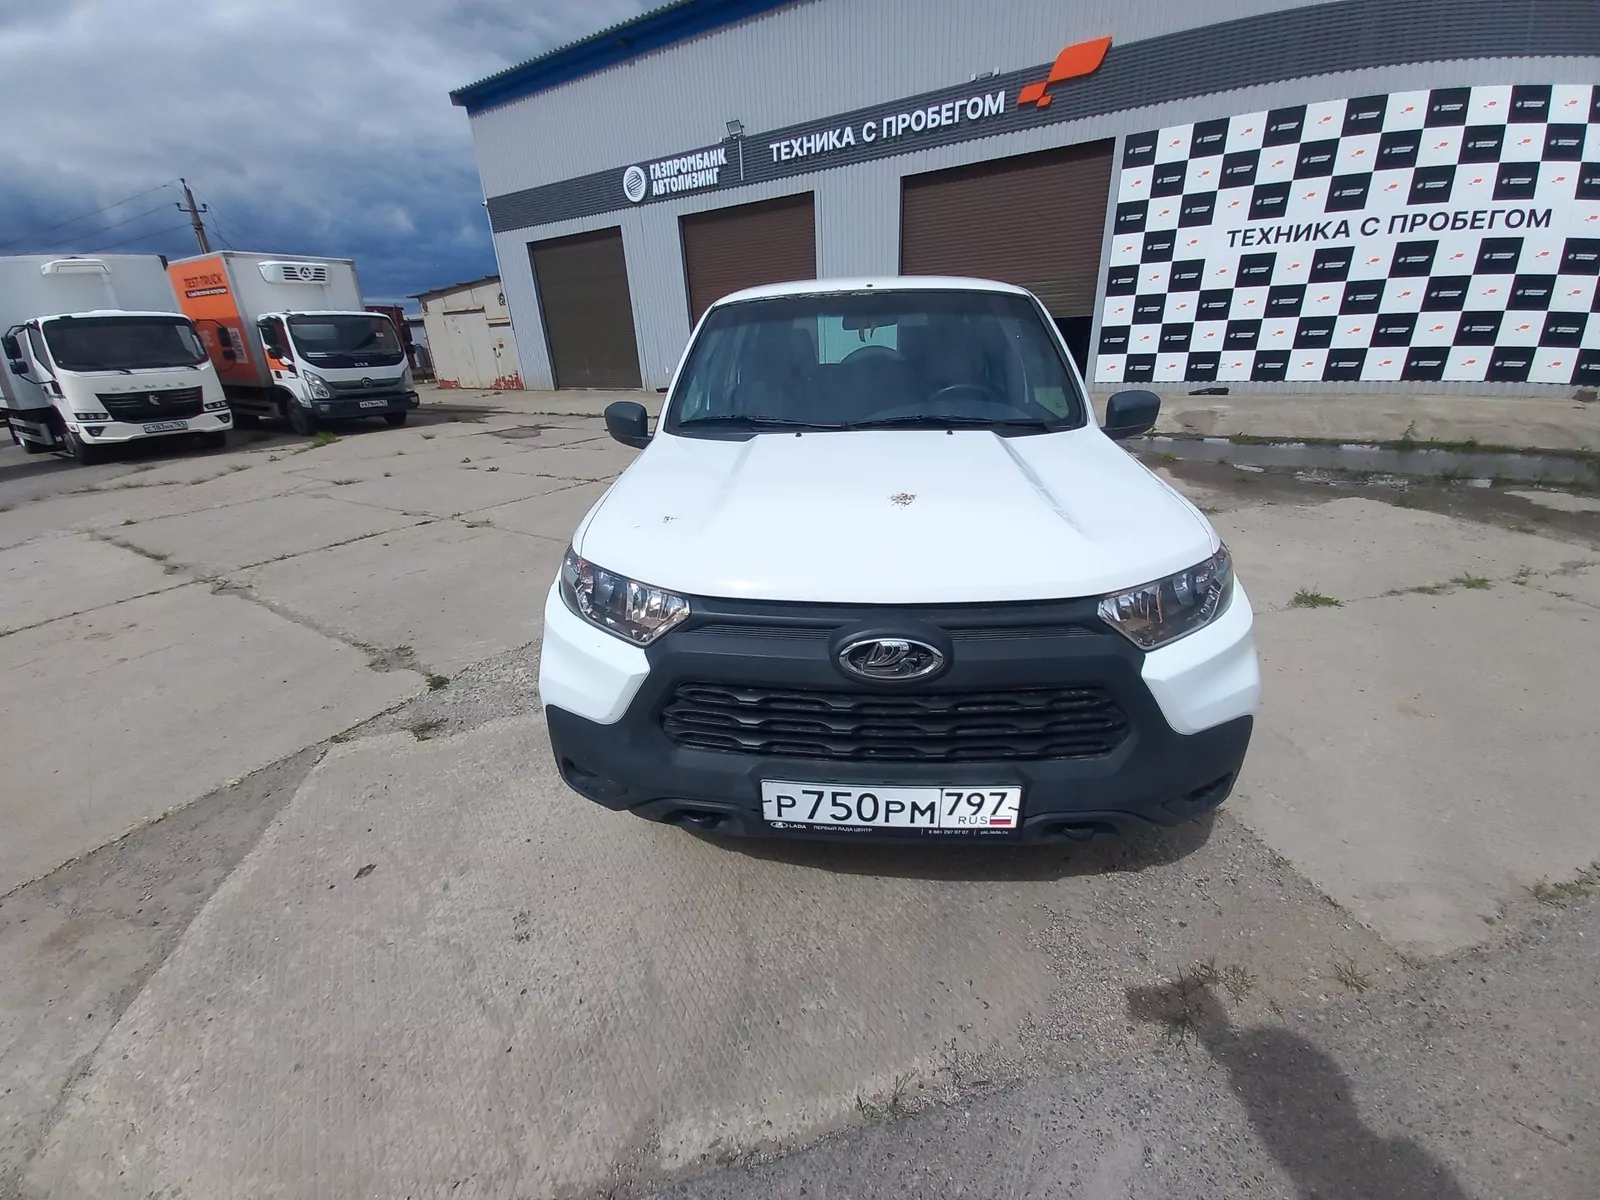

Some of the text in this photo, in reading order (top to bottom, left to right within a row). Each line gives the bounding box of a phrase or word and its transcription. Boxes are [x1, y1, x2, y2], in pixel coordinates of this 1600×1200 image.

[769, 90, 1006, 162] ТЕХНИКА С ПРОБЕГОМ
[649, 147, 728, 180] ГАЗПРОМБАНК
[652, 167, 719, 196] АВТОЛИЗИНГ
[1226, 208, 1553, 249] ТЕХНИКА С ПРОБЕГОМ
[776, 789, 1008, 825] Р750РМ 797
[958, 815, 988, 825] RUS
